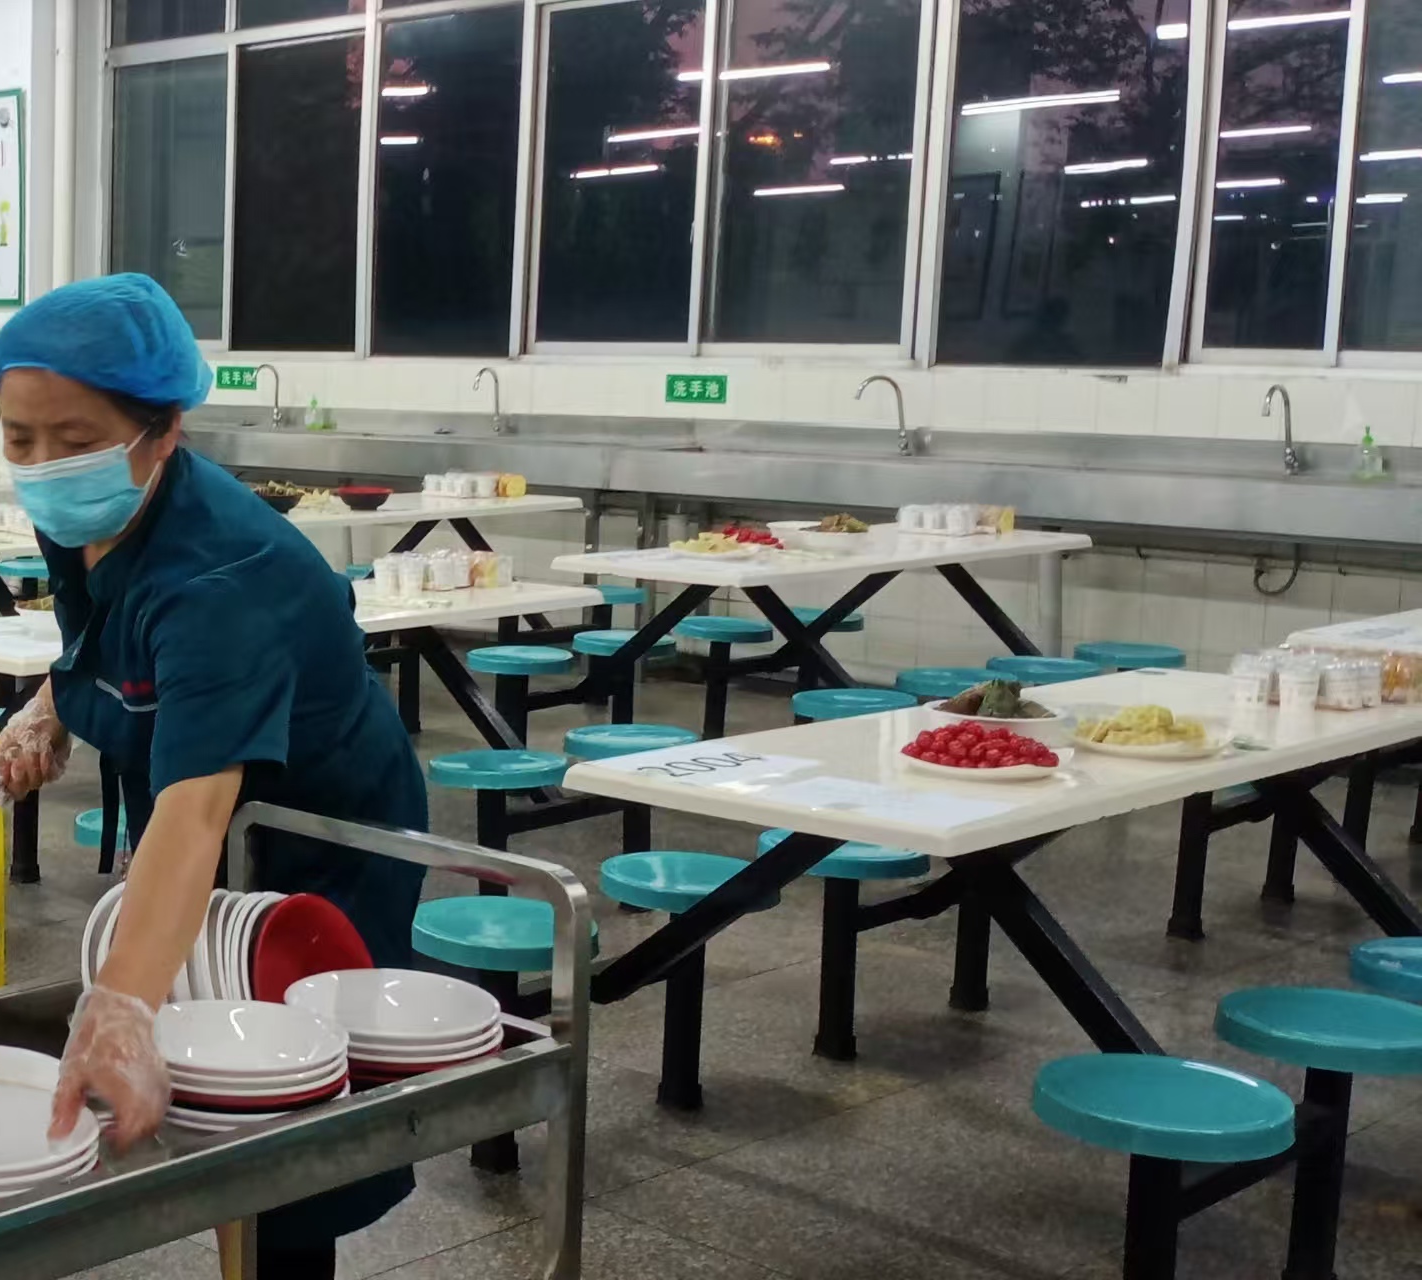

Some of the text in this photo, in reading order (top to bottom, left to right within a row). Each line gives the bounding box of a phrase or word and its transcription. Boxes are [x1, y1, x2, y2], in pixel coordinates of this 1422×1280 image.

[221, 370, 255, 386] 洗手池
[672, 380, 720, 398] 洗手池
[637, 752, 766, 777] 2004
